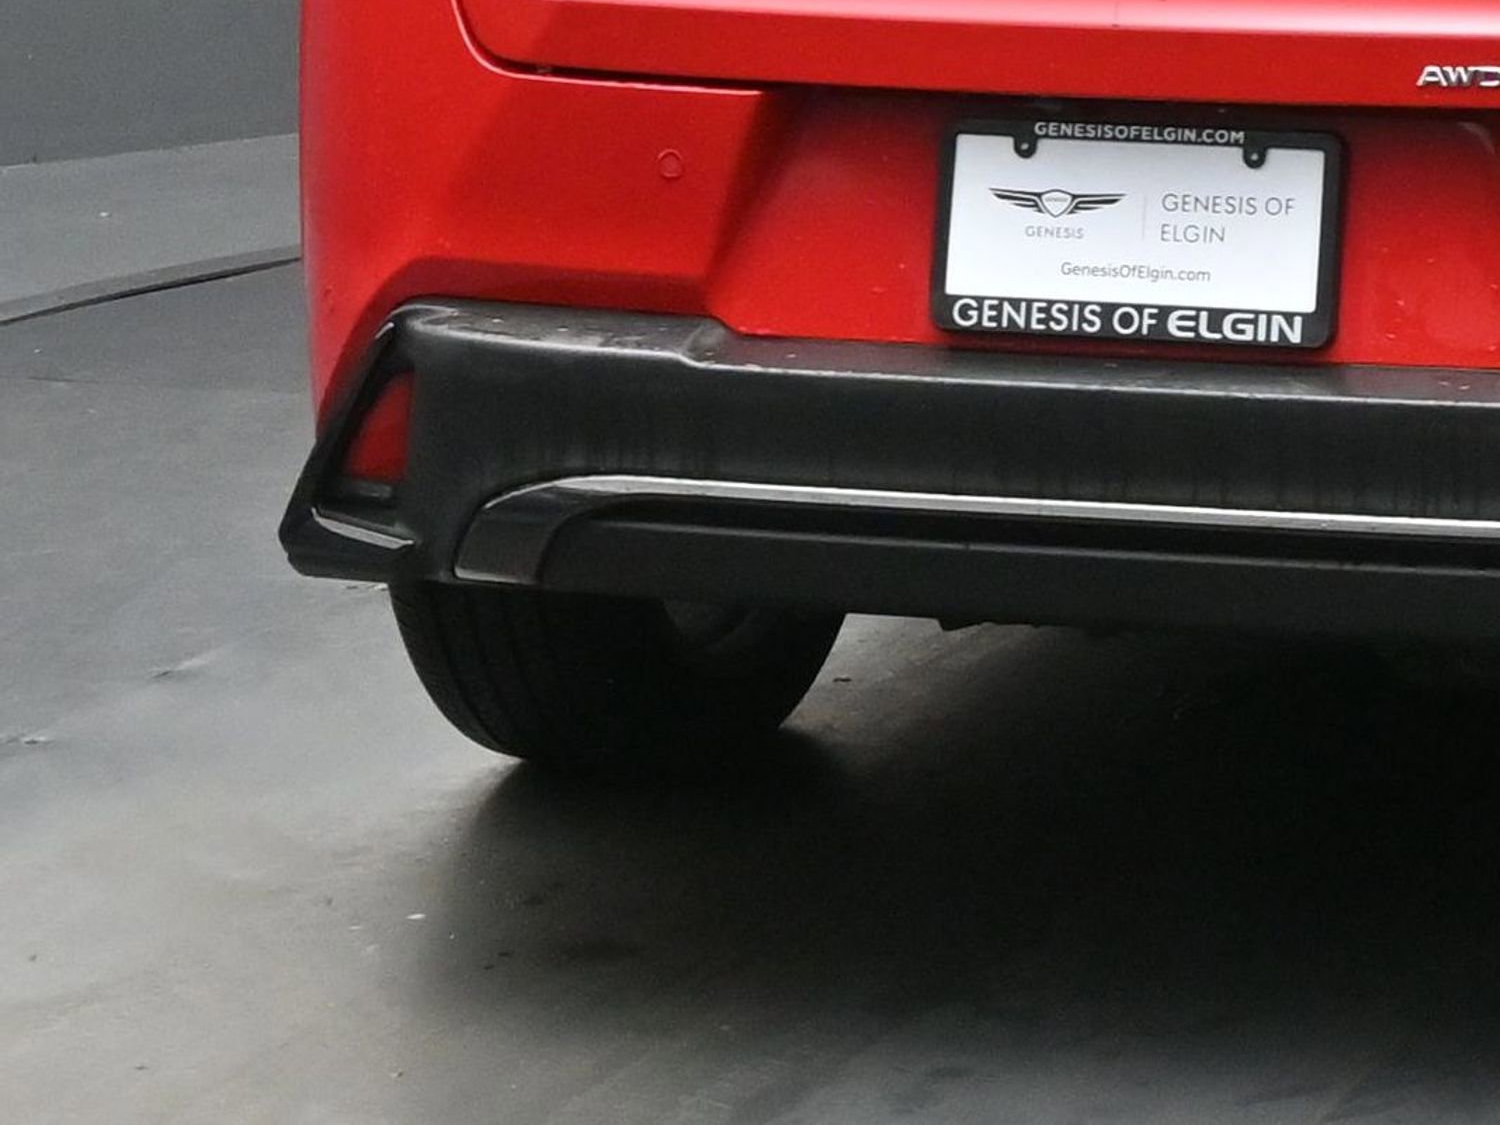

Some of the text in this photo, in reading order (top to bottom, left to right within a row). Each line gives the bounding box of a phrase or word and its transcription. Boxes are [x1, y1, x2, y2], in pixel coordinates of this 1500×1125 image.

[1034, 121, 1245, 144] GENESISOFELGIN.COM
[1161, 192, 1296, 217] GENESIS OF
[1025, 225, 1084, 239] GENESIS
[1160, 223, 1225, 244] ELGIN
[1060, 261, 1211, 283] GenesisOfElgin.com
[952, 298, 1303, 344] GENESIS OF ELGIN
